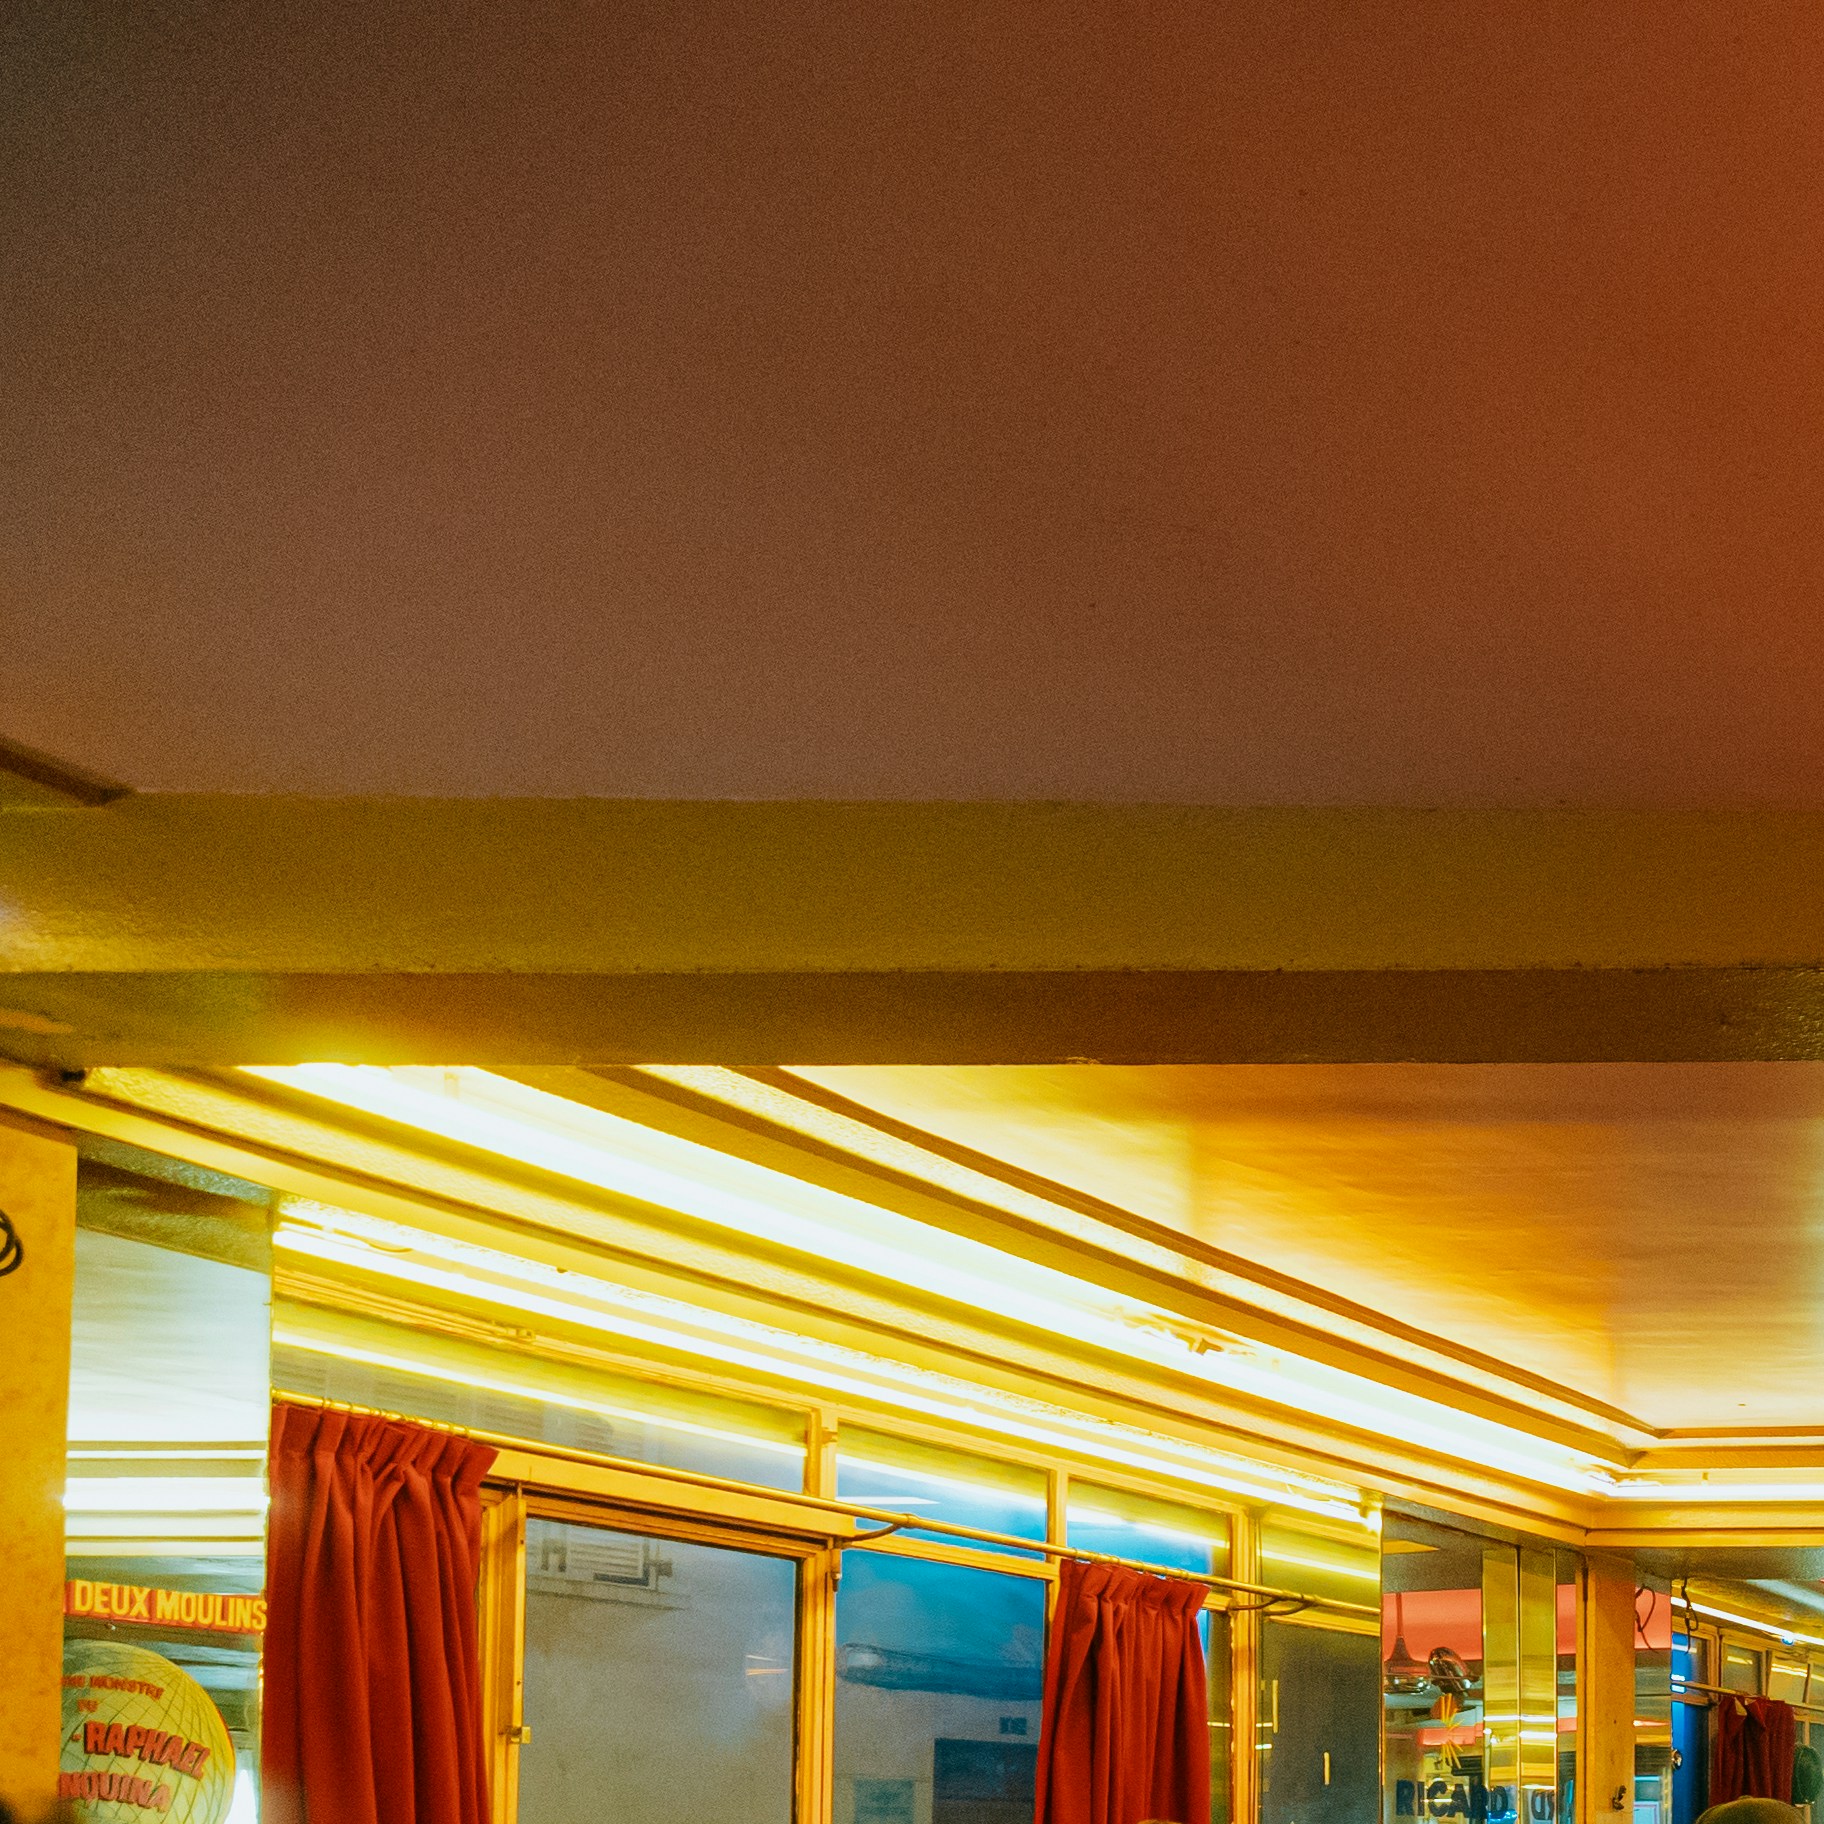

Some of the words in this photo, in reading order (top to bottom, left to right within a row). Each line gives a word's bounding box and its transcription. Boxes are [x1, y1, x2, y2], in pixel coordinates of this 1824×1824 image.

[74, 1579, 151, 1617] DEUX
[155, 1589, 267, 1631] MOULINS
[1395, 1778, 1509, 1821] RICARD
